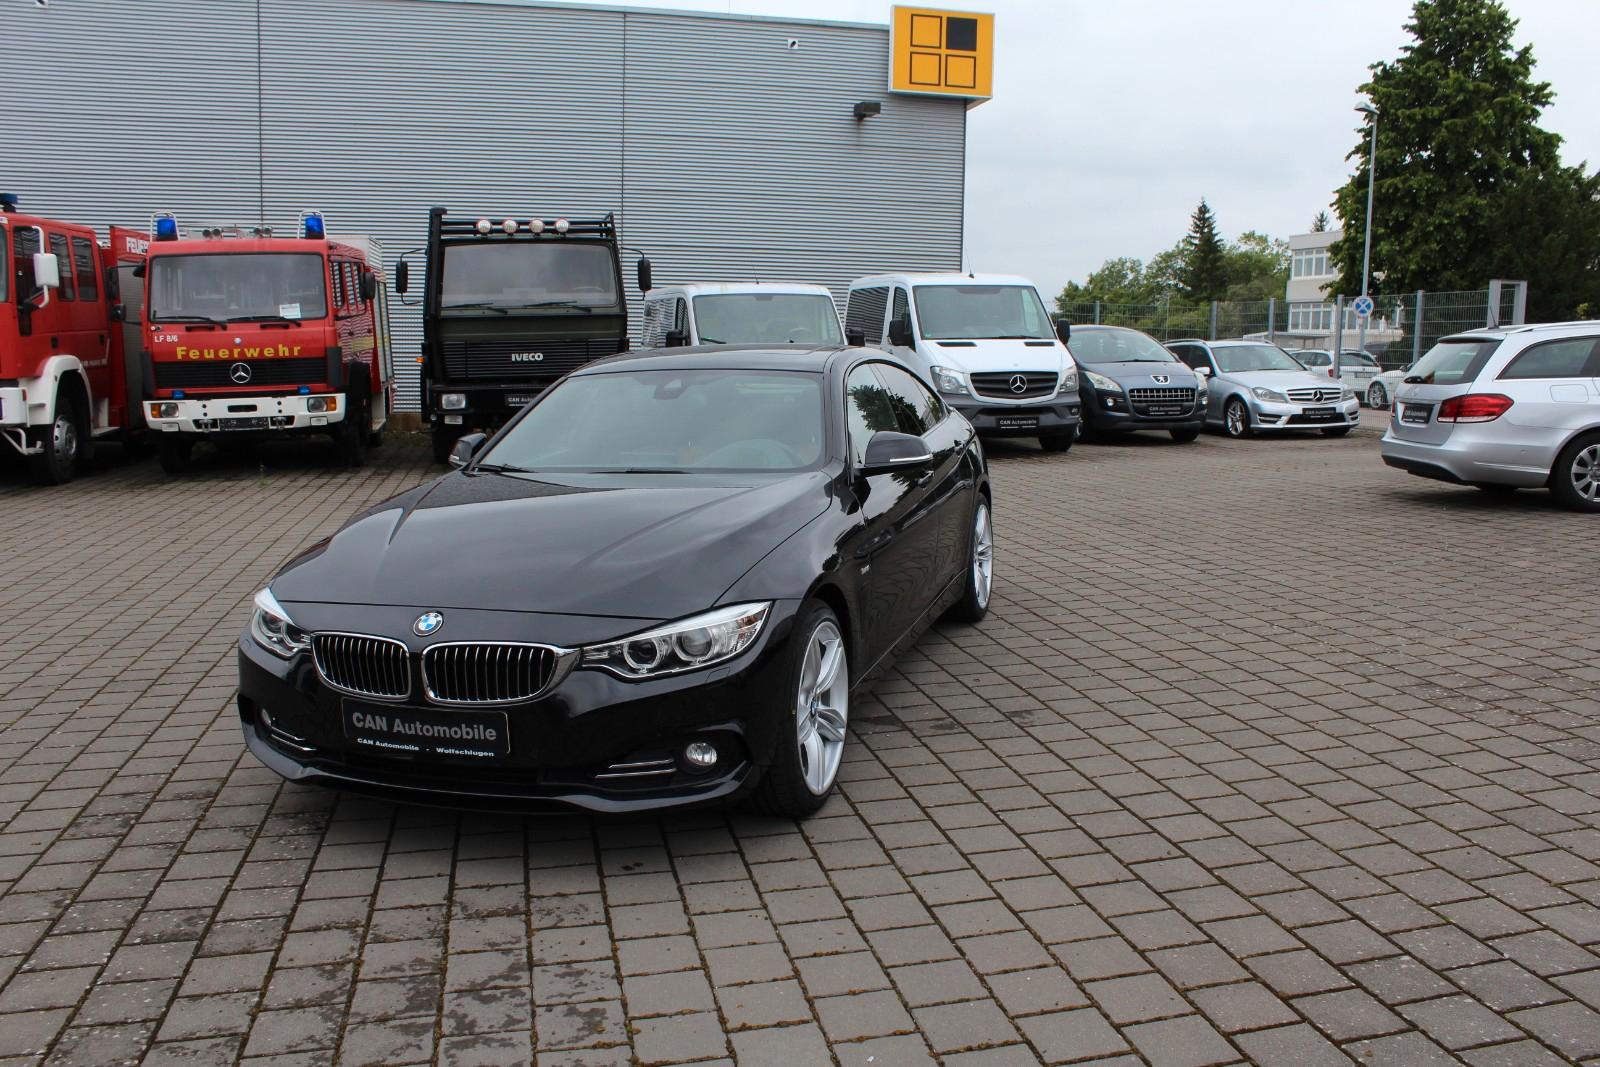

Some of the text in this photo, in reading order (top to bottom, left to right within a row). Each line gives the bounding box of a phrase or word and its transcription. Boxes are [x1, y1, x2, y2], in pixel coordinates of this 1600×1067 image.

[154, 335, 164, 343] LF
[176, 344, 301, 360] Feuerwehr
[511, 352, 544, 361] IVECO
[352, 711, 497, 741] CAN Automobile
[357, 737, 374, 746] CAN
[375, 740, 420, 751] Automobile
[436, 747, 495, 757] Wolfschlugen
